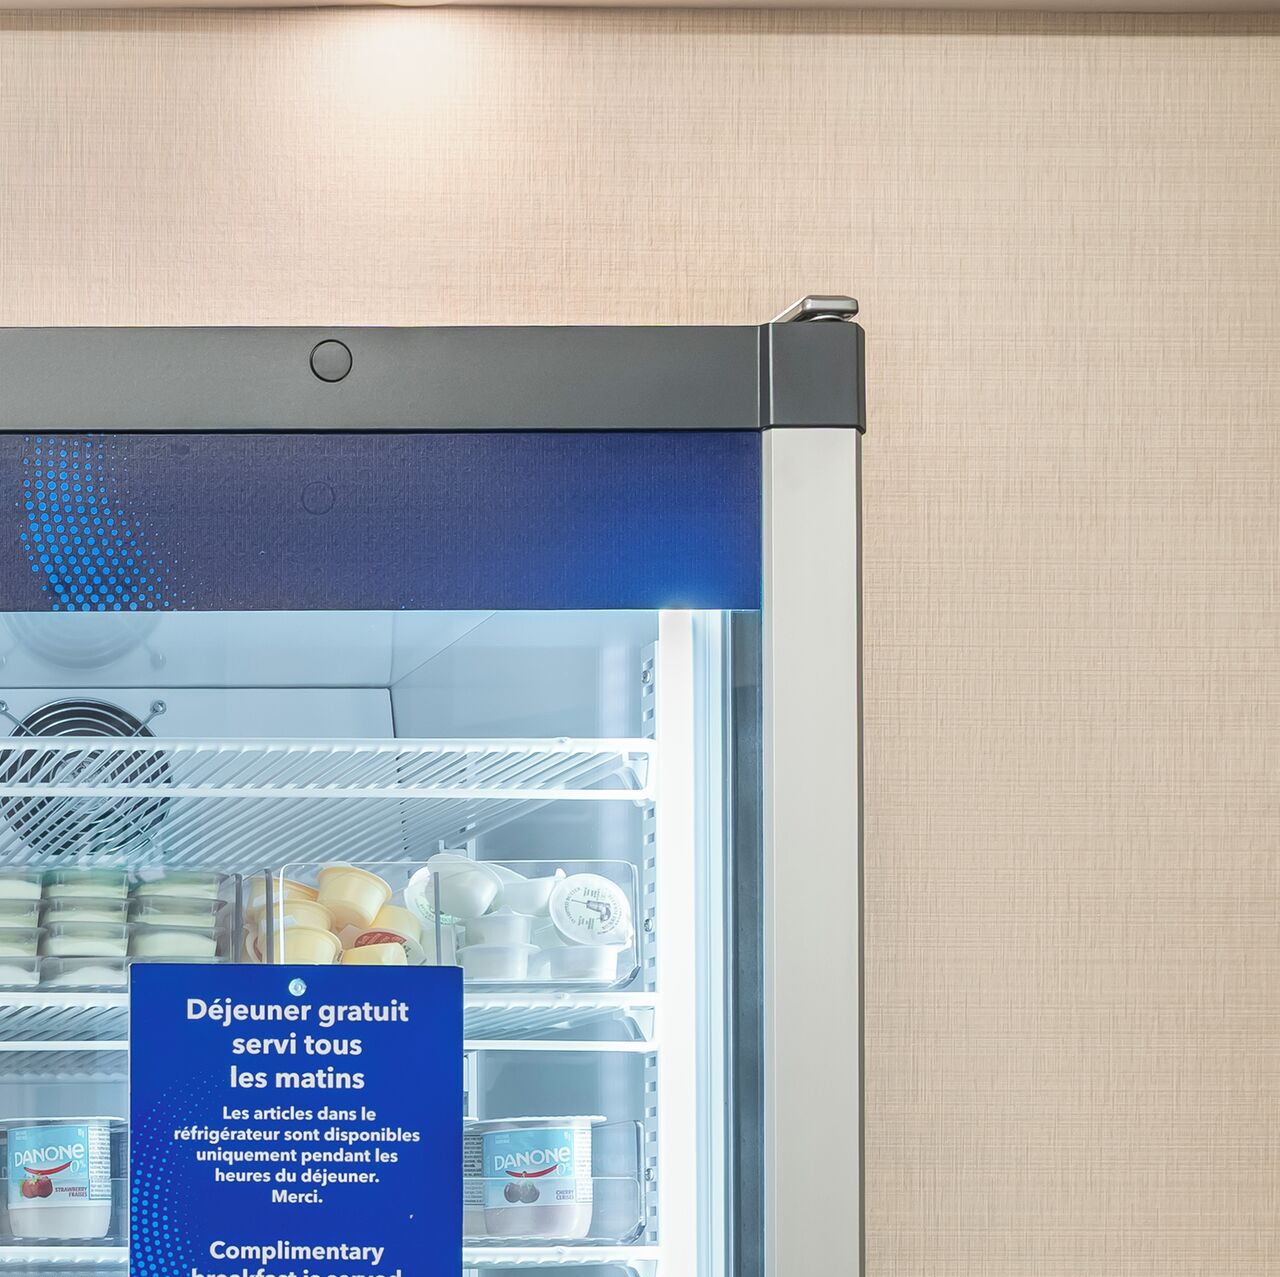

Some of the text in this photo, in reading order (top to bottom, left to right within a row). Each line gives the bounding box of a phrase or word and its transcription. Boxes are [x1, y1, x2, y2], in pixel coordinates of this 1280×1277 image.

[187, 998, 409, 1028] Déjeuner gratuit
[232, 1032, 363, 1056] servi tous
[230, 1065, 365, 1089] les matins
[222, 1105, 377, 1122] Les articles dans le
[173, 1125, 420, 1146] réfrigérateur sont disponibles
[196, 1147, 399, 1165] uniquement pendant les
[215, 1168, 380, 1187] heures du déjeuner.
[271, 1189, 323, 1204] Merci.
[209, 1240, 385, 1266] Complimentary
